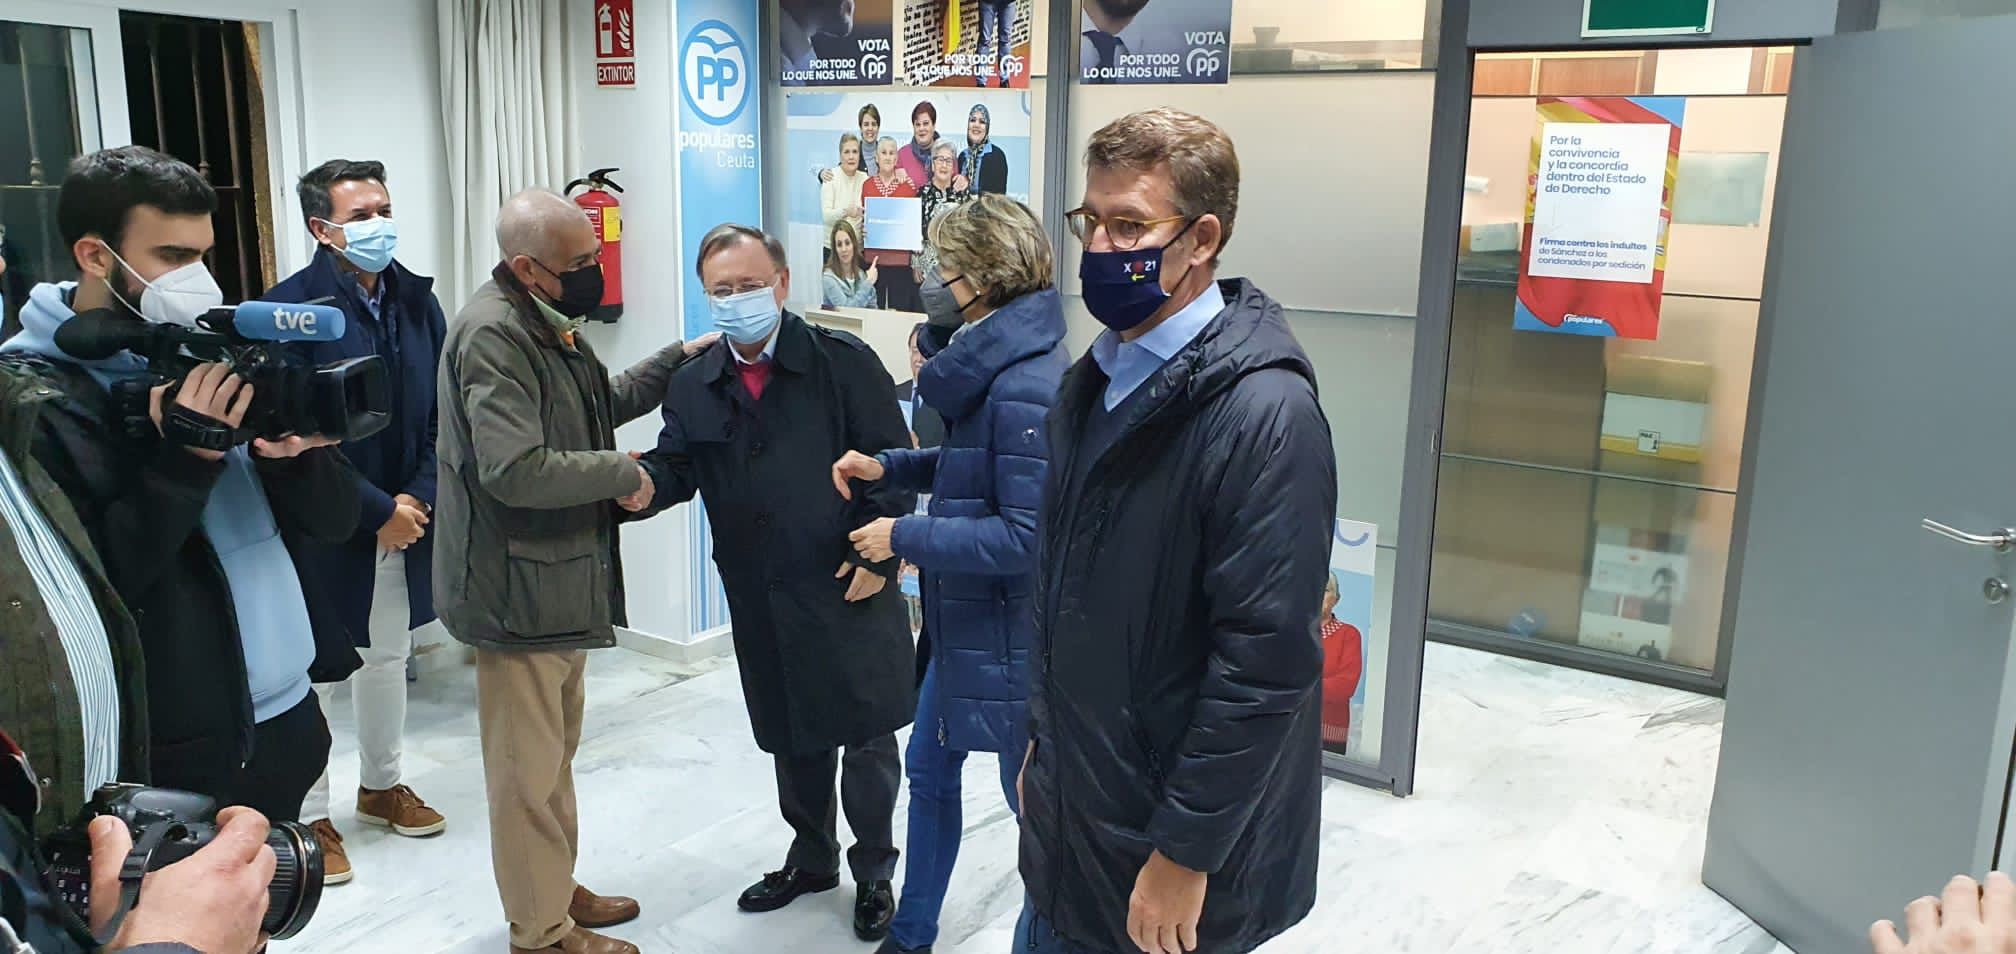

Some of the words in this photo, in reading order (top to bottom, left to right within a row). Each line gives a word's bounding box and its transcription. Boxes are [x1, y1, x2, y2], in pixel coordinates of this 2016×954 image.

[1184, 31, 1226, 46] VOTA
[857, 39, 890, 51] VOTA
[810, 59, 829, 69] POR
[830, 58, 856, 69] TODO
[944, 54, 965, 65] POR
[968, 54, 996, 65] TODO
[1119, 54, 1144, 66] POR
[1146, 54, 1180, 65] TODO
[598, 65, 634, 82] EXTINTOR
[782, 70, 795, 81] LO
[796, 70, 815, 81] QUE
[815, 69, 836, 80] NOS
[836, 69, 858, 80] UNE.
[929, 65, 951, 77] QUE
[951, 65, 972, 76] NOS
[974, 65, 997, 77] UNE.
[1083, 67, 1099, 79] LO
[1100, 67, 1125, 79] QUE
[1127, 66, 1151, 78] NOS
[1153, 66, 1181, 78] UNE.
[696, 56, 739, 101] PP
[680, 130, 755, 153] populares
[1550, 135, 1568, 146] Por
[1571, 135, 1582, 146] la
[1548, 148, 1620, 159] convivencia
[717, 151, 755, 169] Ceuta
[1547, 160, 1555, 171] y
[1556, 159, 1567, 170] la
[1569, 160, 1629, 171] concordia
[1546, 172, 1585, 182] dentro
[1586, 173, 1604, 183] del
[1606, 173, 1646, 184] Estado
[1545, 183, 1560, 193] de
[1562, 184, 1611, 195] Derecho
[1539, 237, 1566, 247] Firma
[1566, 239, 1596, 248] contra
[1596, 240, 1609, 249] los
[1610, 241, 1647, 250] indultos
[1551, 247, 1586, 258] Sánchez
[1595, 250, 1608, 258] los
[1144, 260, 1157, 271] 21
[1537, 257, 1591, 267] condenados
[1592, 260, 1607, 268] por
[1608, 260, 1646, 270] sedición
[273, 306, 318, 335] tve
